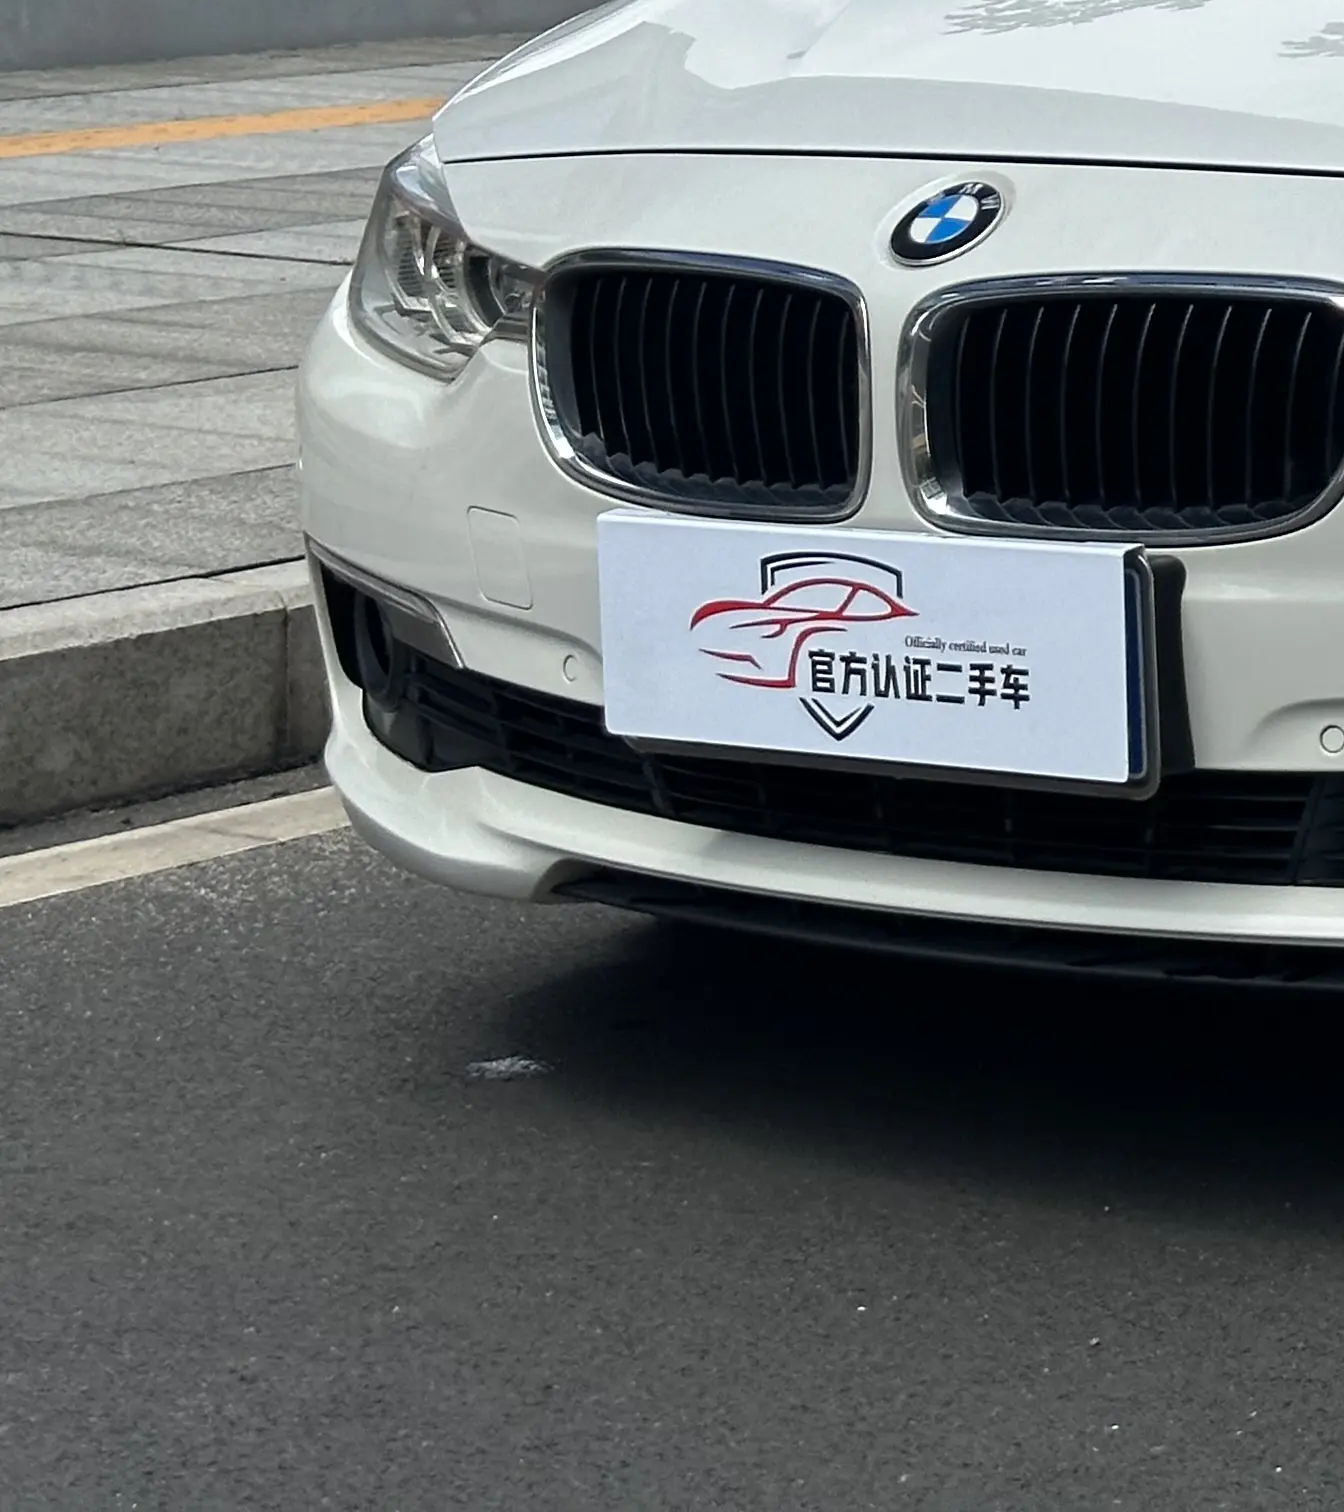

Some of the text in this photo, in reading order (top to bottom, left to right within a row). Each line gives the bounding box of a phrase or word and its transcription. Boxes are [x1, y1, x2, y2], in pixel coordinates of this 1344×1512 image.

[1011, 647, 1028, 656] car
[808, 648, 1031, 710] 官方认证二手车
